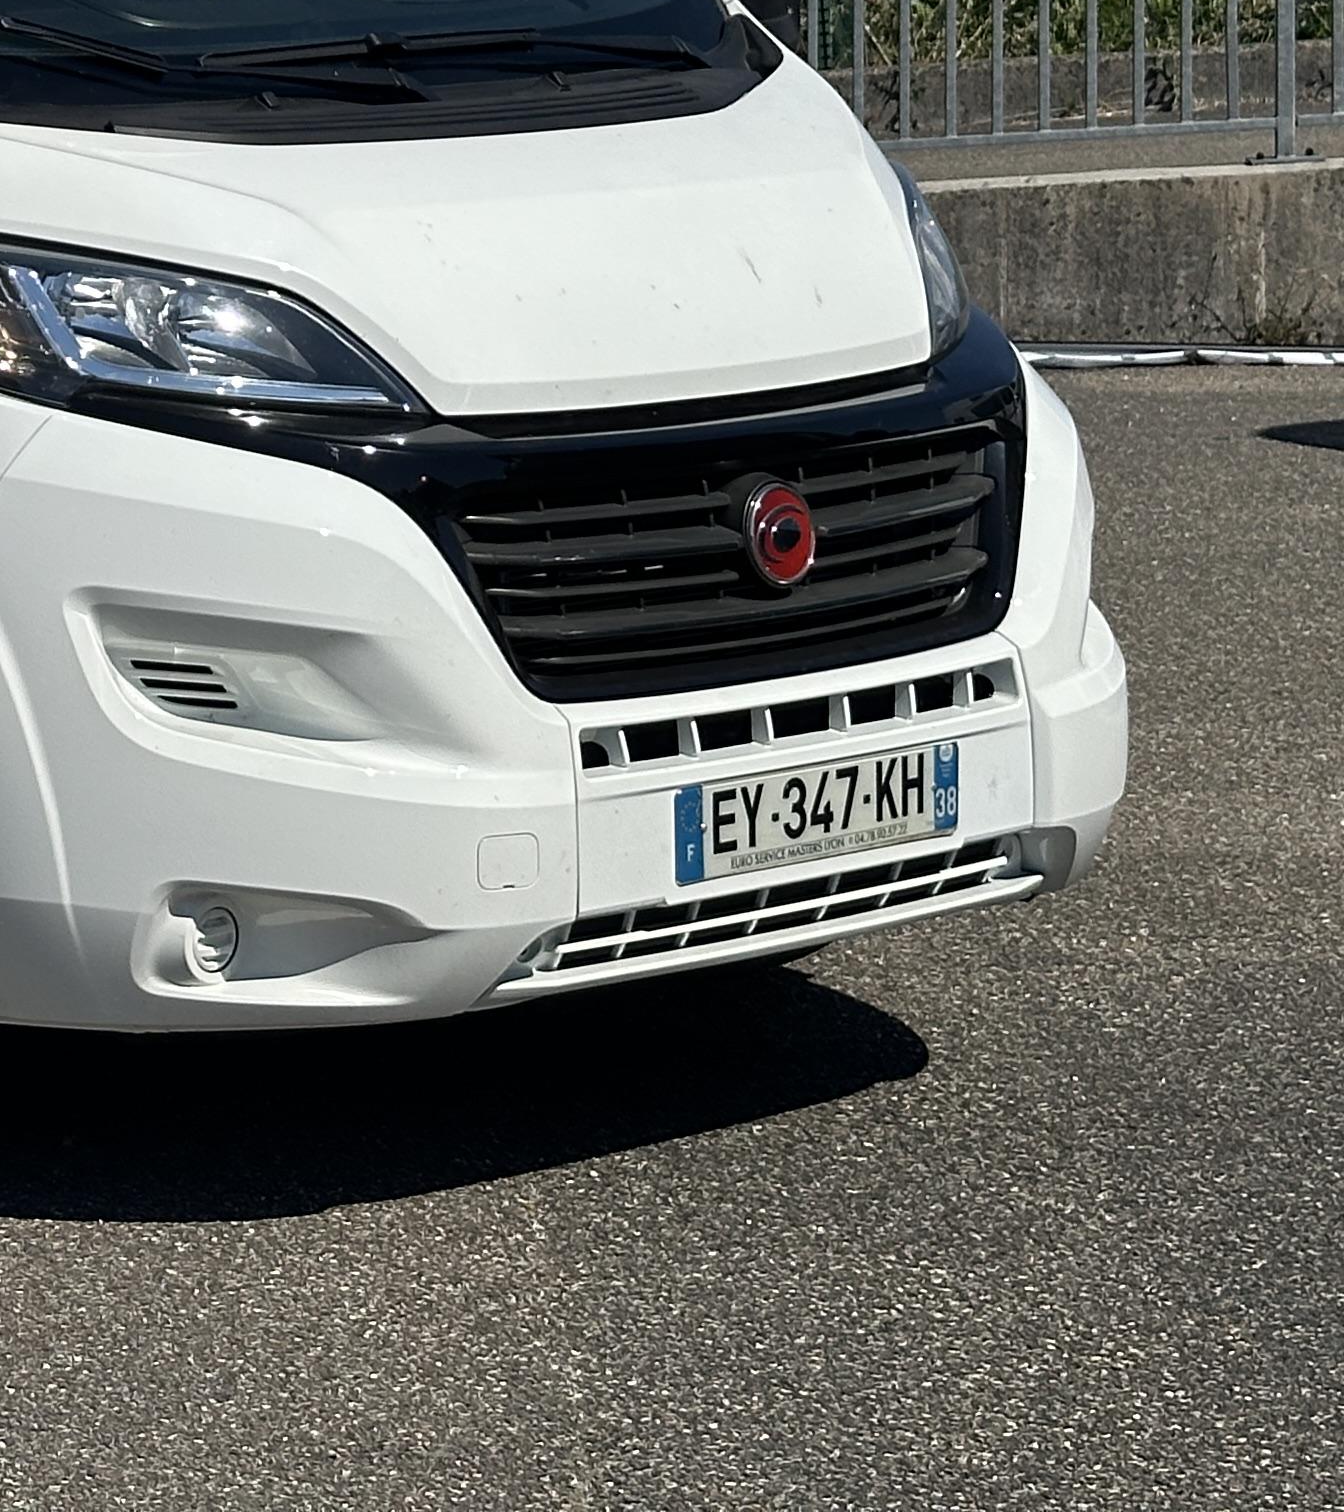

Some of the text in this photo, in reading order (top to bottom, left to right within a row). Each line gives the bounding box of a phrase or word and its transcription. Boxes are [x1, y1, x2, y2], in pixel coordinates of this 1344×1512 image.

[935, 786, 957, 818] 38
[687, 843, 694, 862] F
[730, 855, 753, 869] EURO
[754, 846, 786, 865] SERVICE
[787, 840, 823, 857] MASTERS
[824, 837, 845, 851] LYON
